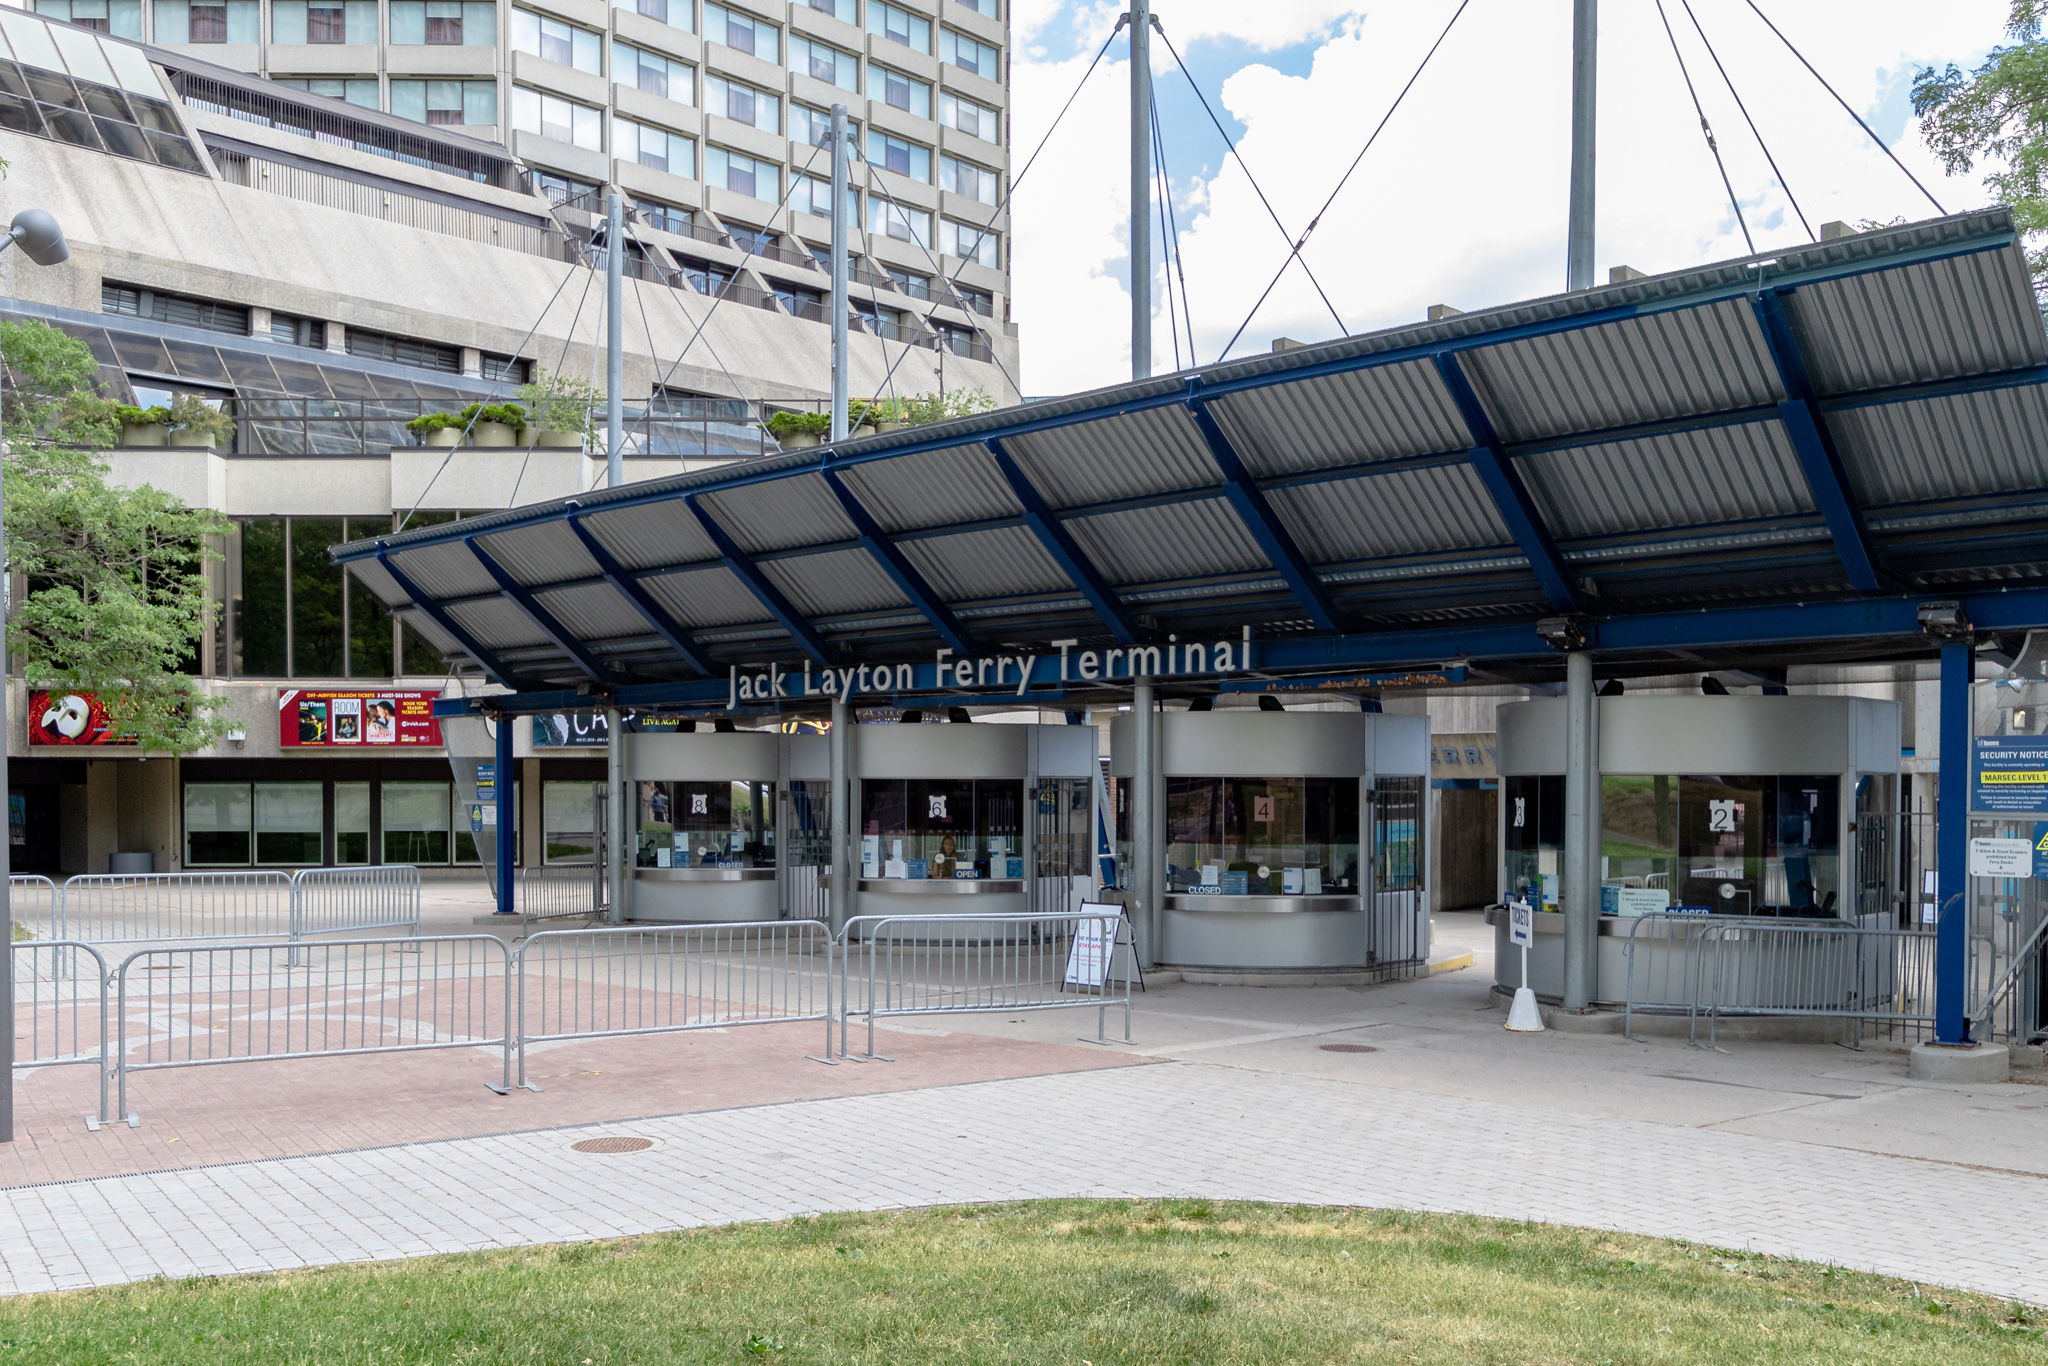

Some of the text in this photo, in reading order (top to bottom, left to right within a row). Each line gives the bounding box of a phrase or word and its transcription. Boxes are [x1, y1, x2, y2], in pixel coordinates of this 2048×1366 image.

[726, 625, 1250, 710] Jack Layton Ferry Terminal
[334, 702, 359, 713] ROOM
[1979, 751, 2048, 759] SECURITY NOTICE
[695, 799, 703, 814] 8
[932, 801, 942, 817] 6
[1258, 802, 1270, 819] 4
[1517, 806, 1522, 825] 3
[1714, 808, 1728, 829] 2
[956, 870, 978, 878] OPEN
[1188, 886, 1222, 895] CLOSED
[1512, 906, 1528, 927] TICKETS
